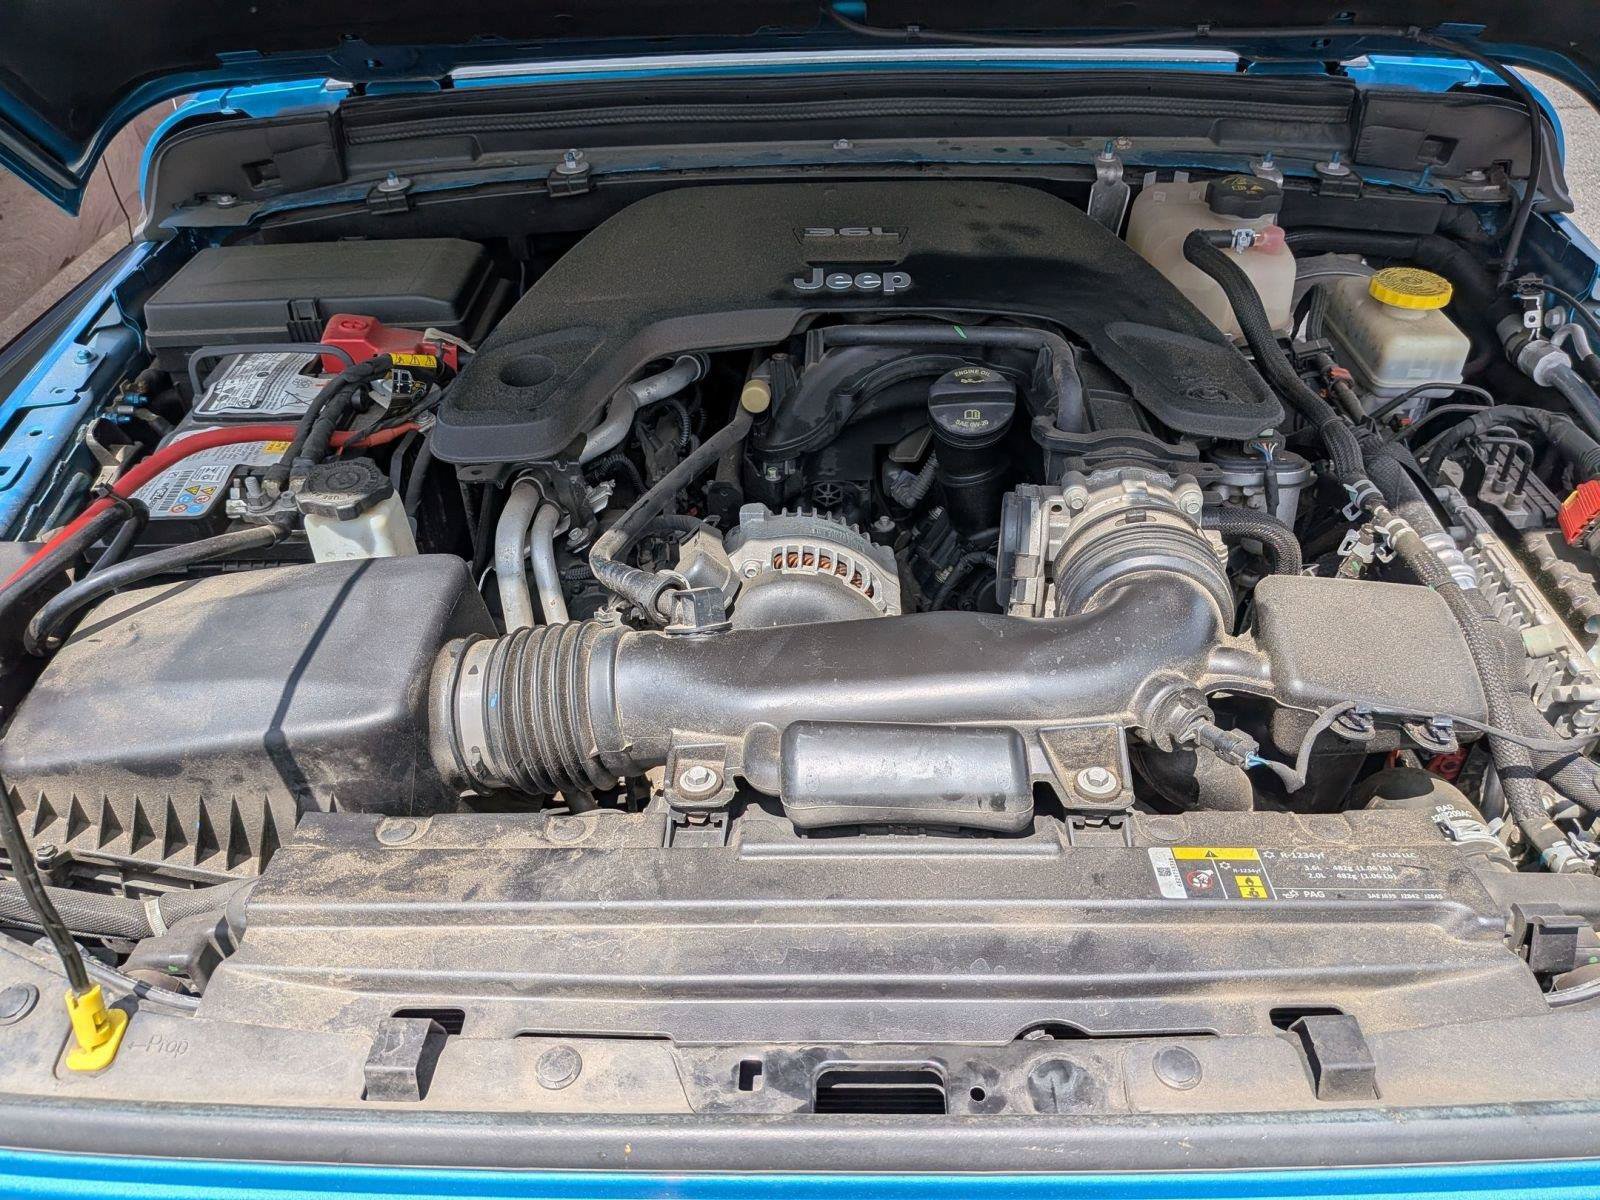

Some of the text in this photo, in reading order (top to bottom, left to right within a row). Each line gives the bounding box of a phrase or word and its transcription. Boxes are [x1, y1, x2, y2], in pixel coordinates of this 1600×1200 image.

[803, 227, 899, 236] 3.6L
[793, 267, 912, 292] Jeep
[954, 369, 980, 377] ENGINE
[955, 419, 989, 428] SAE 0W-20
[1434, 804, 1455, 813] RAD
[1280, 851, 1326, 860] R-1234yf
[1303, 890, 1326, 898] PAG
[145, 1033, 189, 1059] Prop
